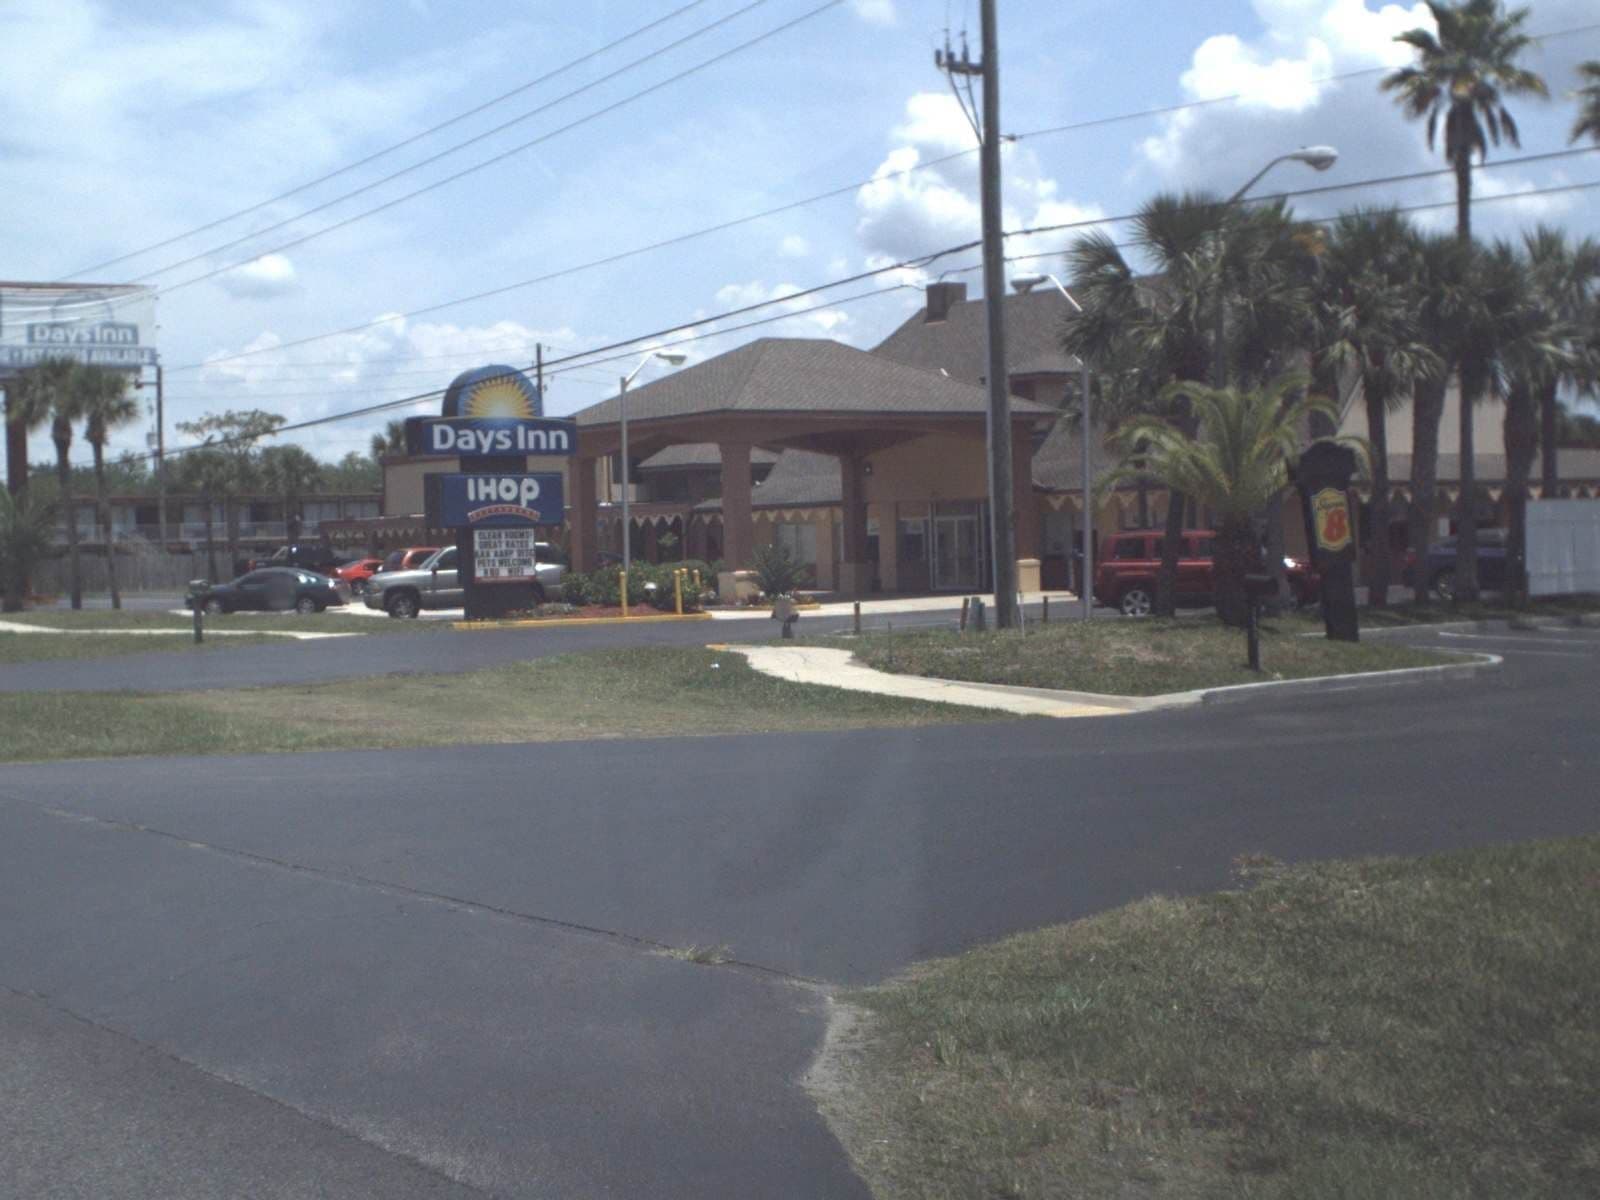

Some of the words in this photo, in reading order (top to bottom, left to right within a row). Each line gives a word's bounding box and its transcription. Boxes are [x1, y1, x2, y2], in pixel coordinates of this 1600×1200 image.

[34, 325, 92, 344] Days
[96, 325, 133, 342] Inn
[432, 424, 512, 454] Days
[517, 425, 569, 450] Inn
[467, 478, 540, 508] IHOP
[1323, 508, 1347, 542] 8
